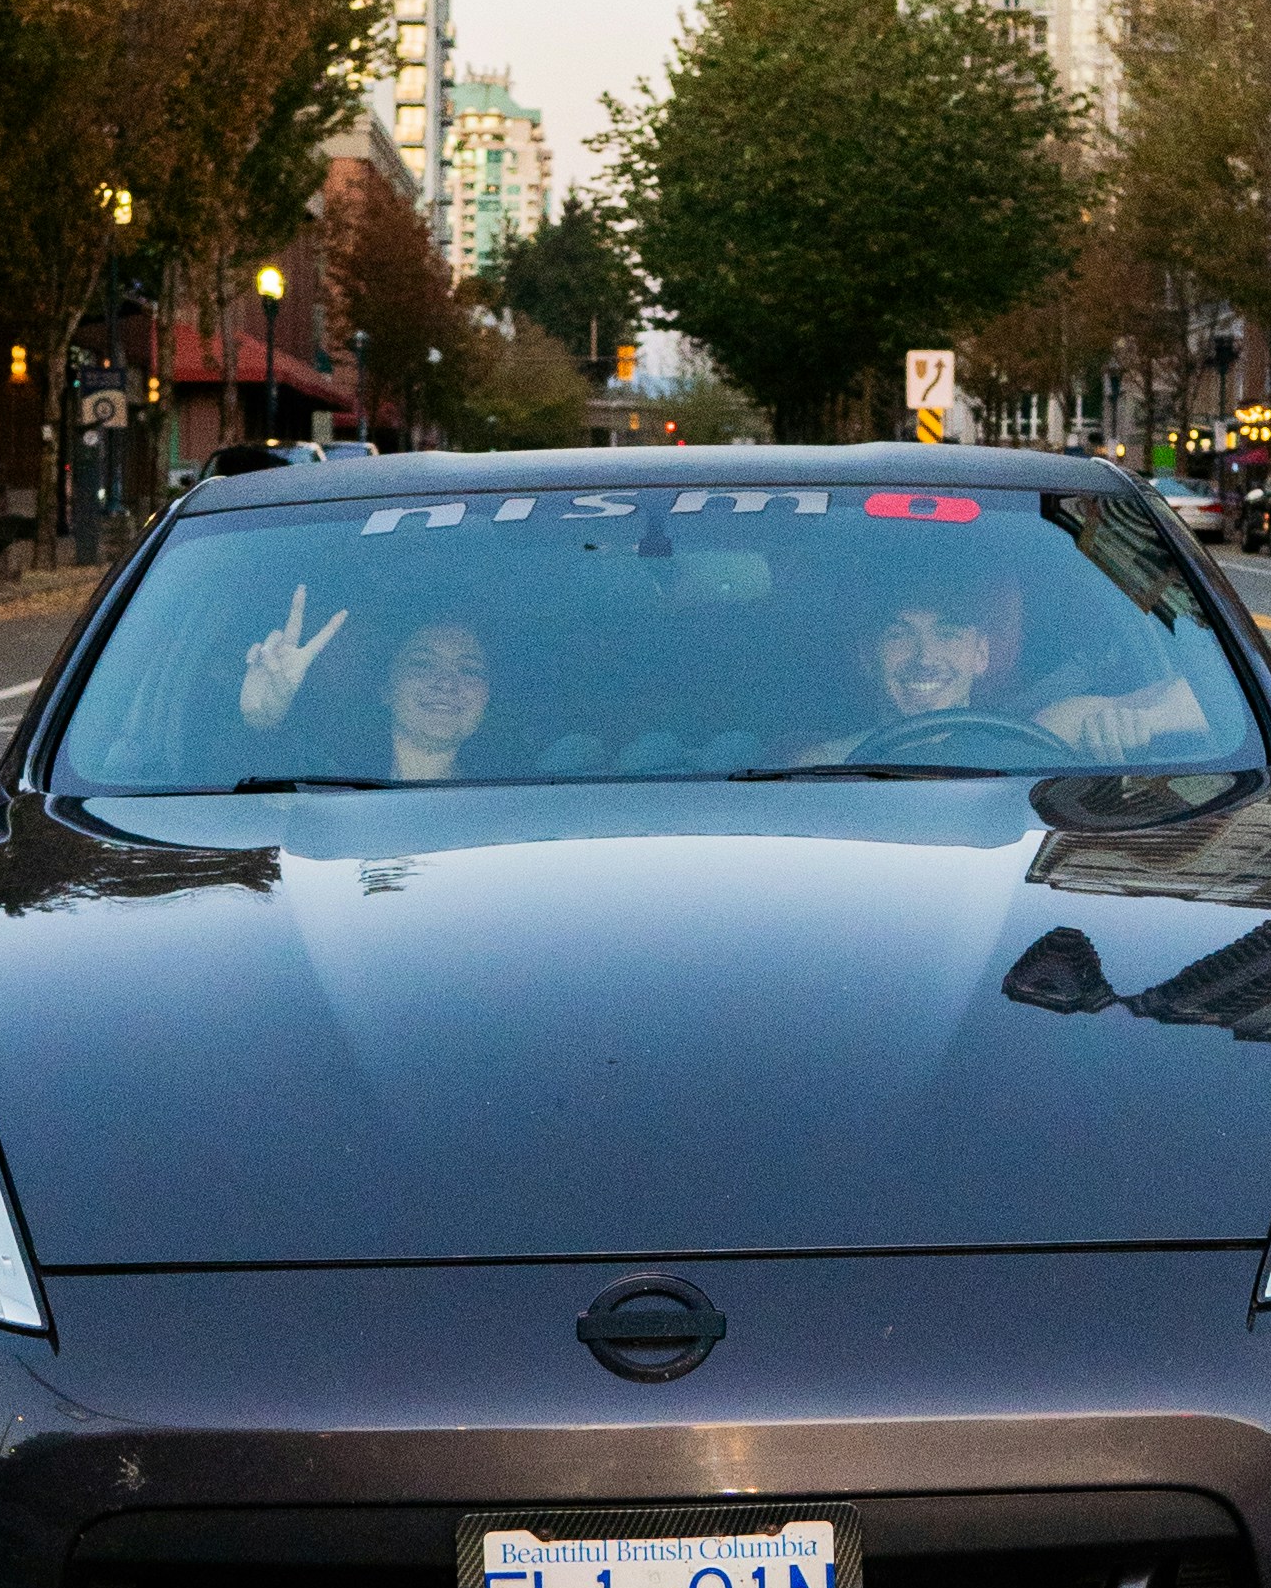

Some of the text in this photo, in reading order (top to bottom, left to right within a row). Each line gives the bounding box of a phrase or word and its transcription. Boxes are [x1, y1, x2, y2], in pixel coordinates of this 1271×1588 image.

[360, 490, 981, 536] nismo
[501, 1534, 818, 1565] Beautiful British Columbia
